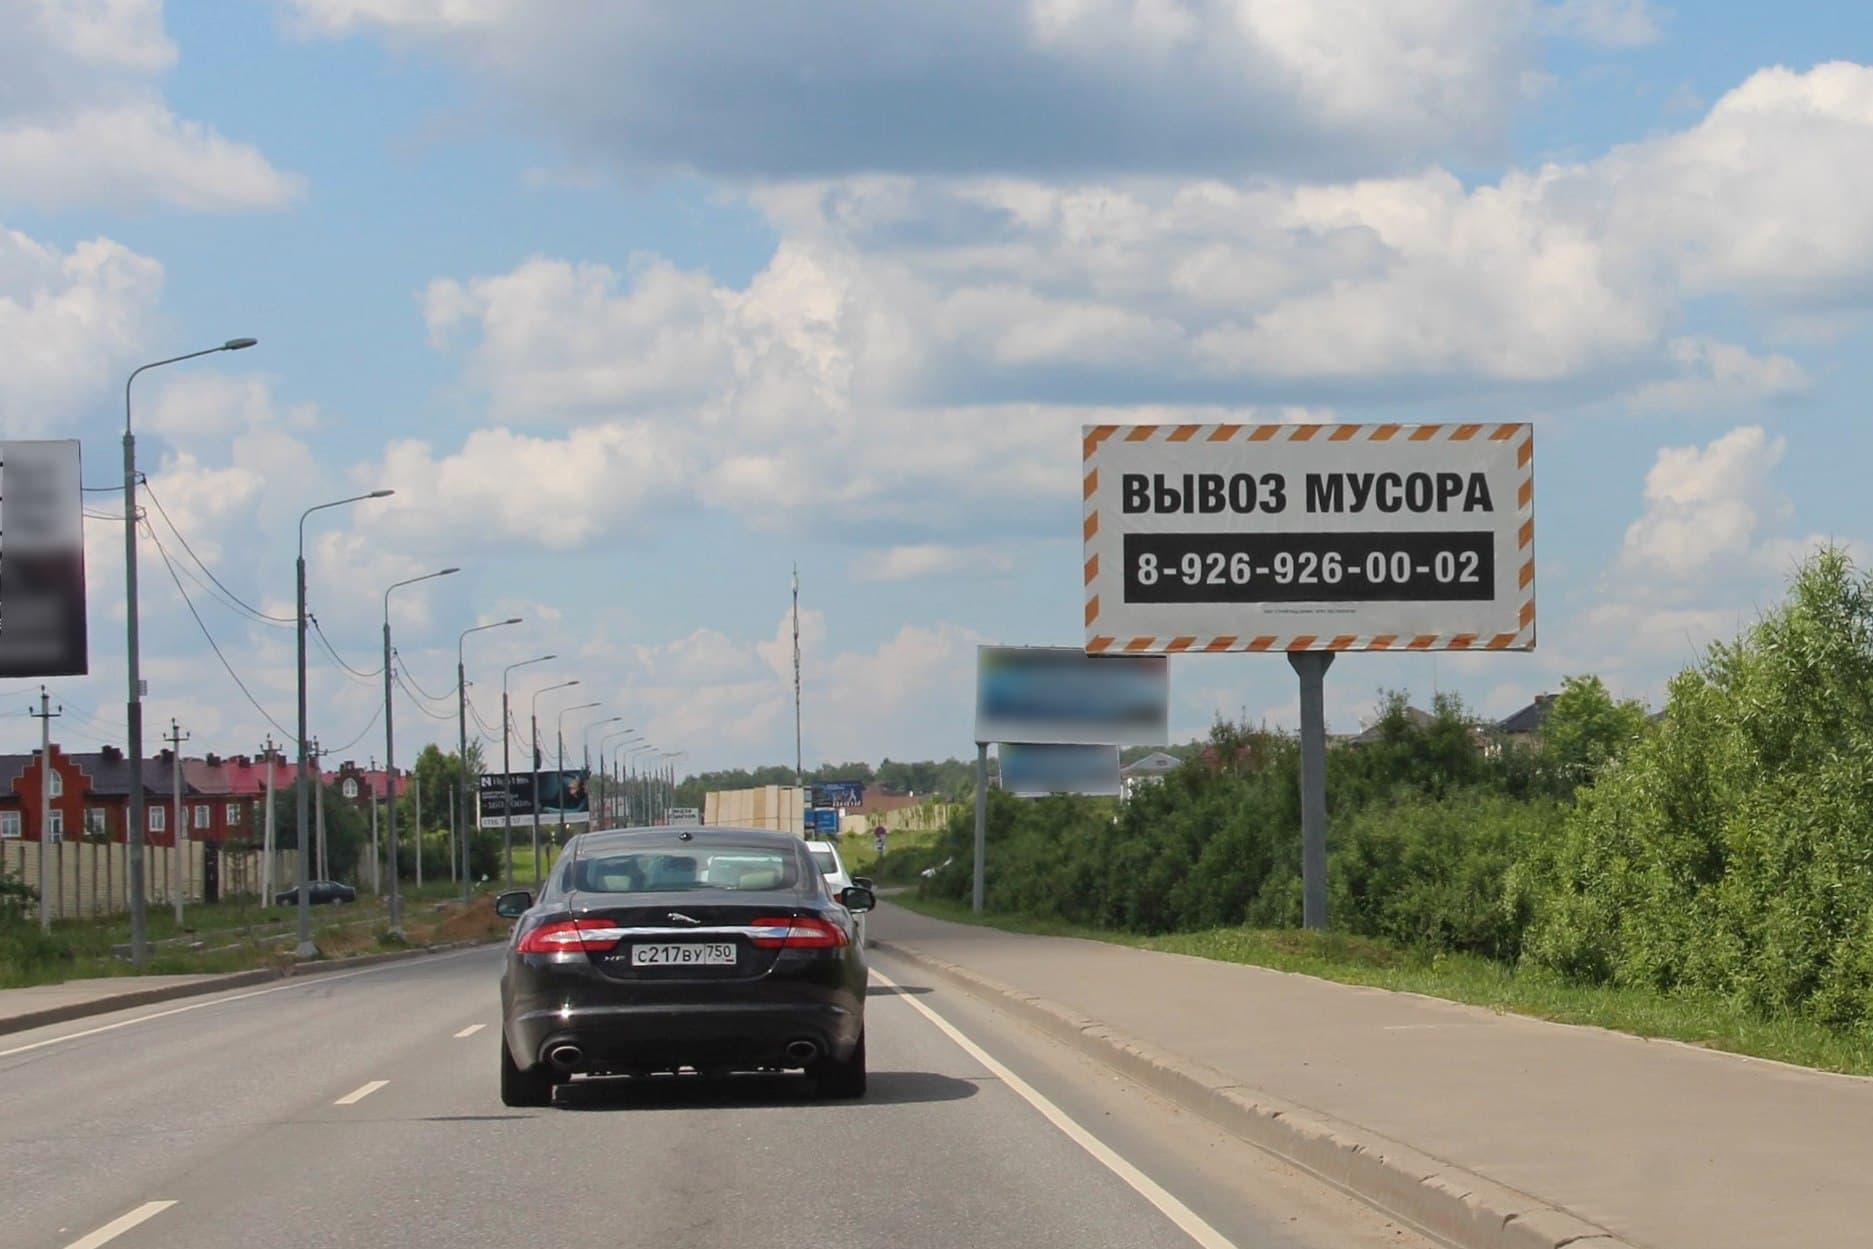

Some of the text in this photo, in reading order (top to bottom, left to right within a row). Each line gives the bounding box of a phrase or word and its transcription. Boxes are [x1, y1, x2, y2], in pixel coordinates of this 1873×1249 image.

[1123, 472, 1494, 513] ВЫВОЗ МУСОРА
[1137, 551, 1480, 585] 8-926-926-00-02
